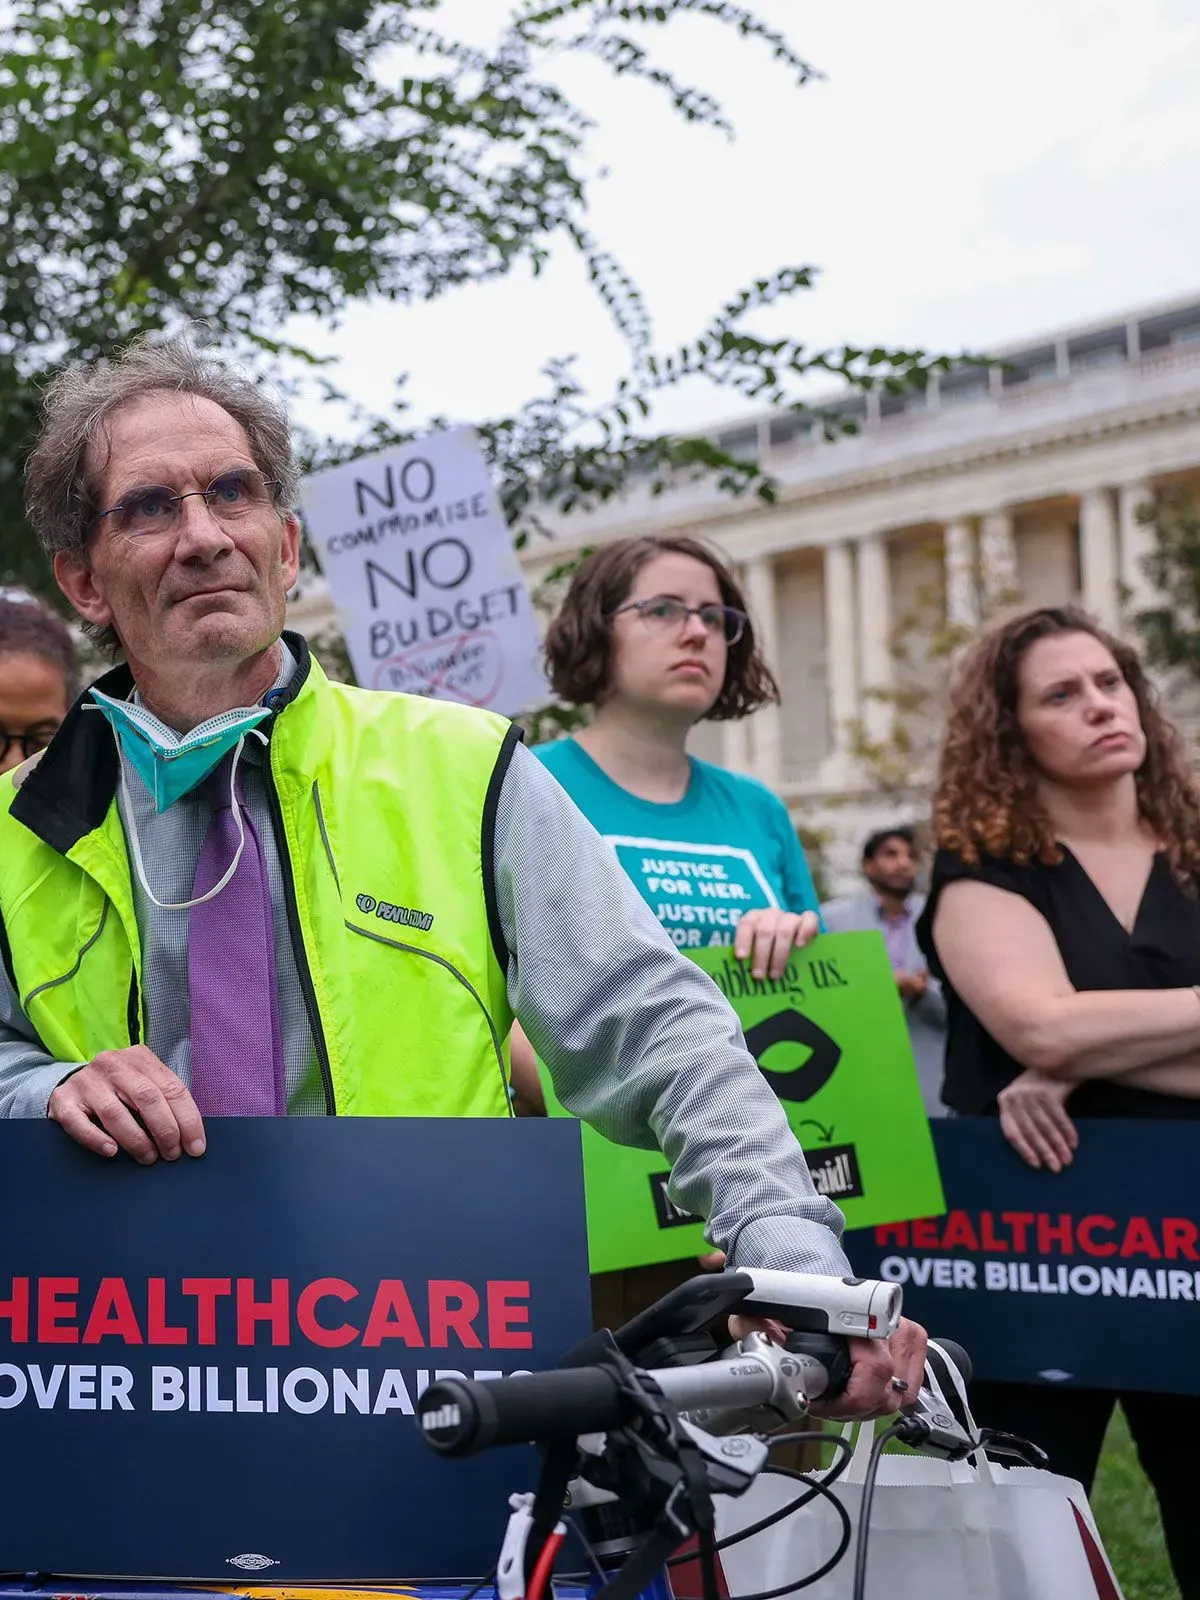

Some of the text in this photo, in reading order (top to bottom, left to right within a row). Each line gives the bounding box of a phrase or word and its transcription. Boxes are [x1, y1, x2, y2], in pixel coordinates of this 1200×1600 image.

[355, 456, 435, 517] NO
[327, 492, 490, 555] COMPROMISE
[365, 537, 474, 611] NO
[369, 582, 524, 659] BUDGET
[377, 901, 408, 924] PEARL
[647, 878, 752, 900] FOR HER.
[656, 904, 742, 926] JUSTICE
[808, 957, 848, 989] us.
[875, 1210, 1200, 1261] HEALTHCAR
[880, 1256, 1200, 1301] OVER BILLIONAIR
[151, 1364, 535, 1415] BILLIONAI
